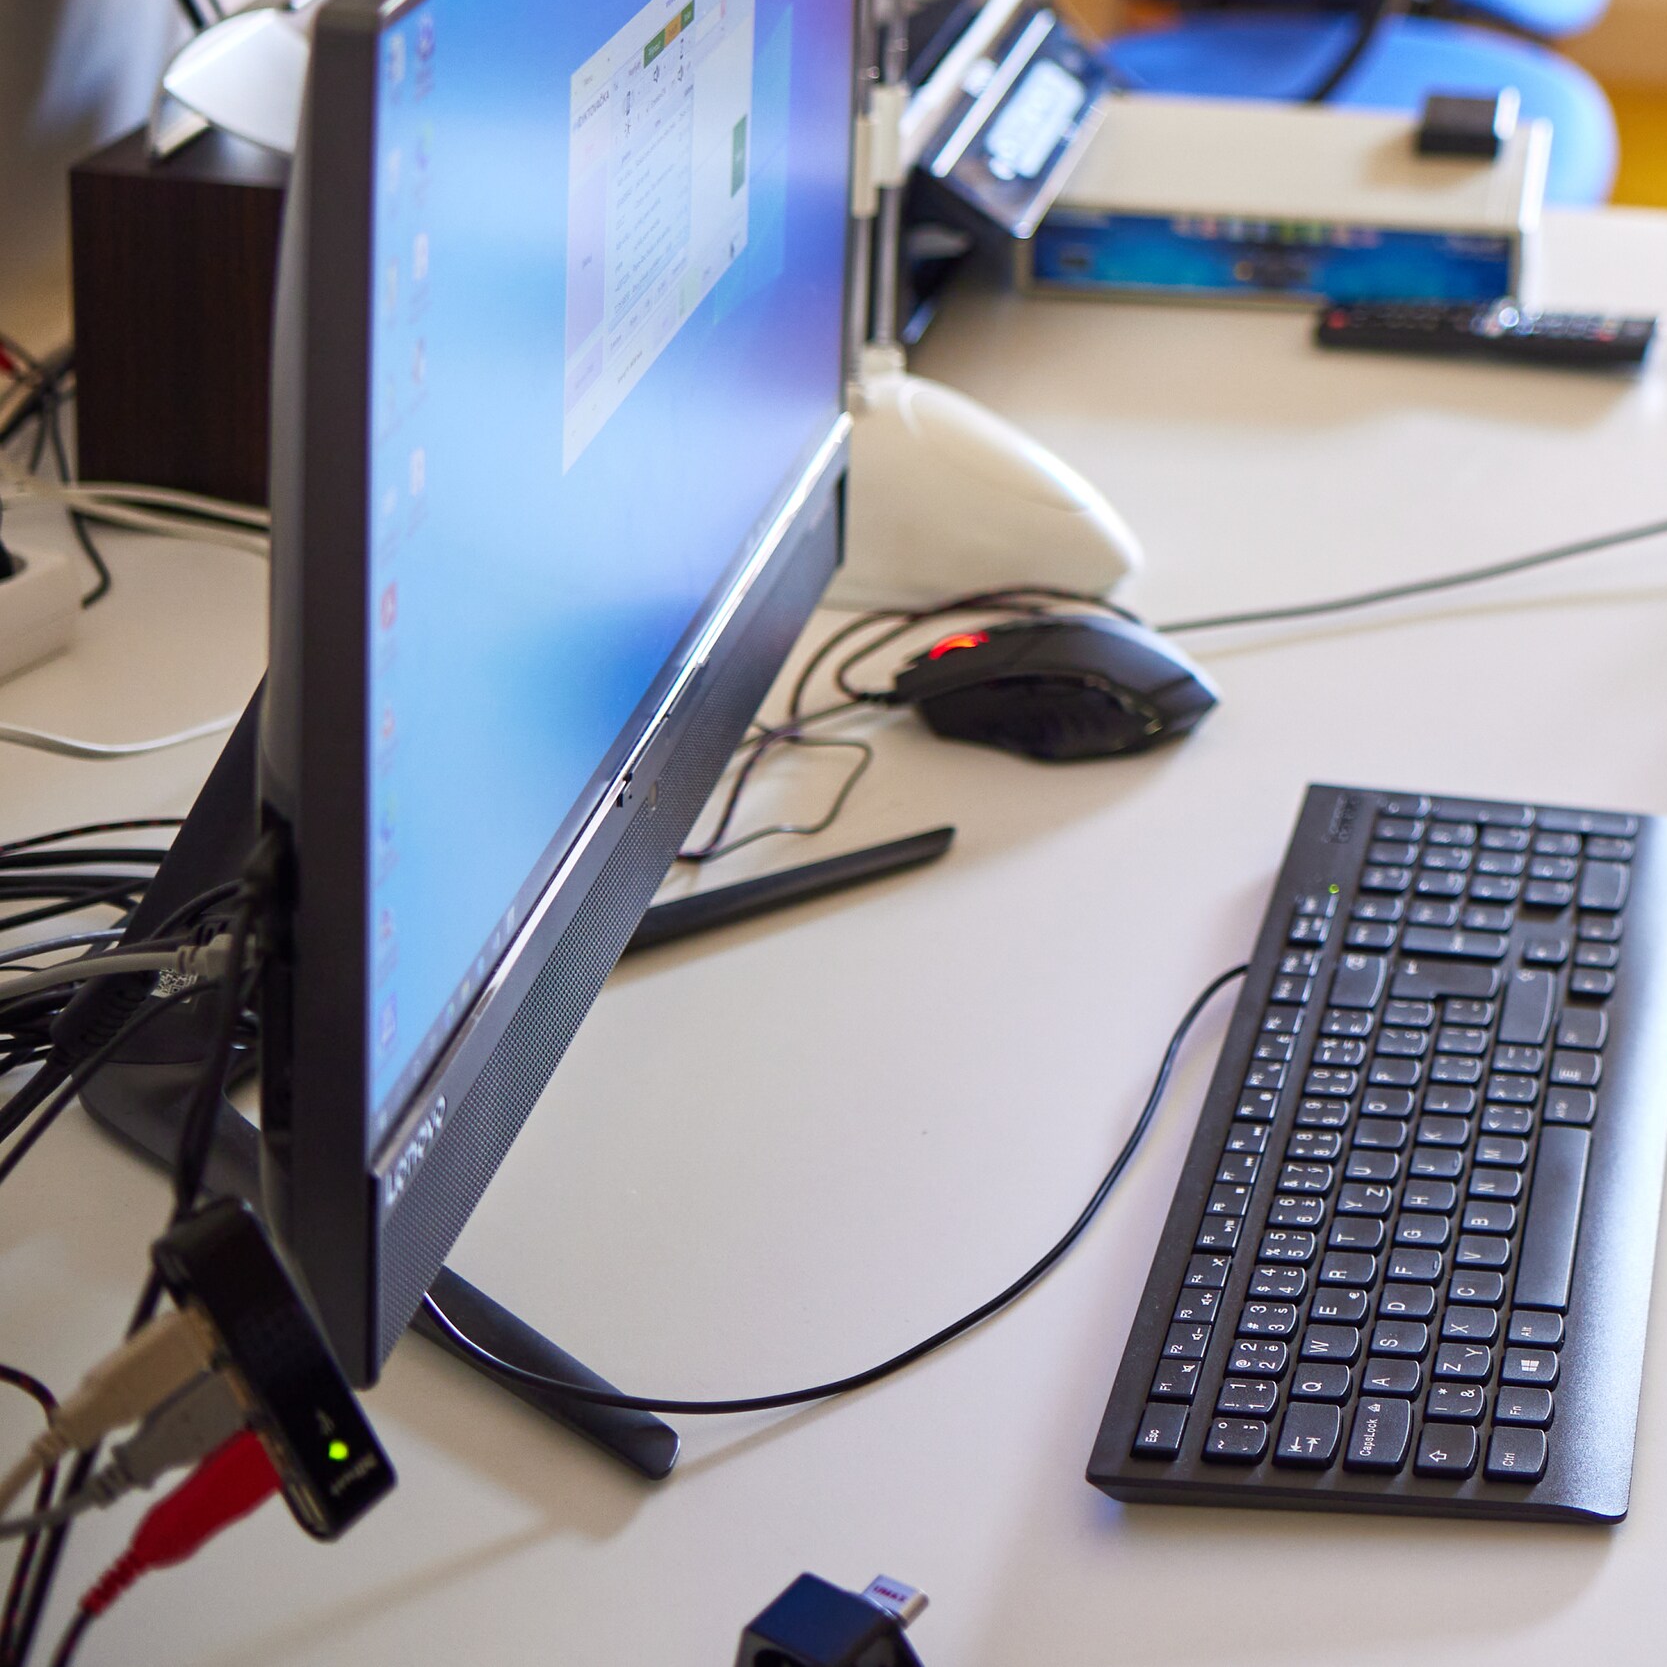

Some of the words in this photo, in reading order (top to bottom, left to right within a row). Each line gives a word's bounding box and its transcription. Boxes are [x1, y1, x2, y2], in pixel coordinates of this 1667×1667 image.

[1366, 1188, 1384, 1197] Z
[1344, 1201, 1363, 1209] Y
[1410, 1196, 1429, 1205] H
[1470, 1217, 1489, 1226] B
[1270, 1233, 1286, 1241] 5
[1336, 1233, 1355, 1242] T
[1403, 1230, 1422, 1239] G
[1287, 1250, 1304, 1258] 5
[1463, 1251, 1482, 1260] V
[1261, 1268, 1276, 1277] 4
[1329, 1270, 1349, 1279] R
[1394, 1266, 1413, 1275] F
[1278, 1286, 1295, 1294] 4
[1457, 1287, 1476, 1297] C
[1250, 1305, 1267, 1314] 3
[1319, 1306, 1338, 1315] E
[1387, 1302, 1406, 1311] D
[1268, 1323, 1285, 1331] 3
[1450, 1323, 1469, 1334] X
[1240, 1343, 1257, 1351] 2
[1309, 1340, 1329, 1353] W
[1380, 1338, 1399, 1348] S
[1464, 1347, 1483, 1358] Y
[1258, 1361, 1276, 1369] 2
[1443, 1362, 1462, 1372] Z
[1371, 1377, 1391, 1387] A
[1302, 1382, 1323, 1392] Q
[1509, 1405, 1522, 1416] Fn
[1359, 1418, 1379, 1457] CapsLock
[1502, 1451, 1516, 1467] Ctrl
